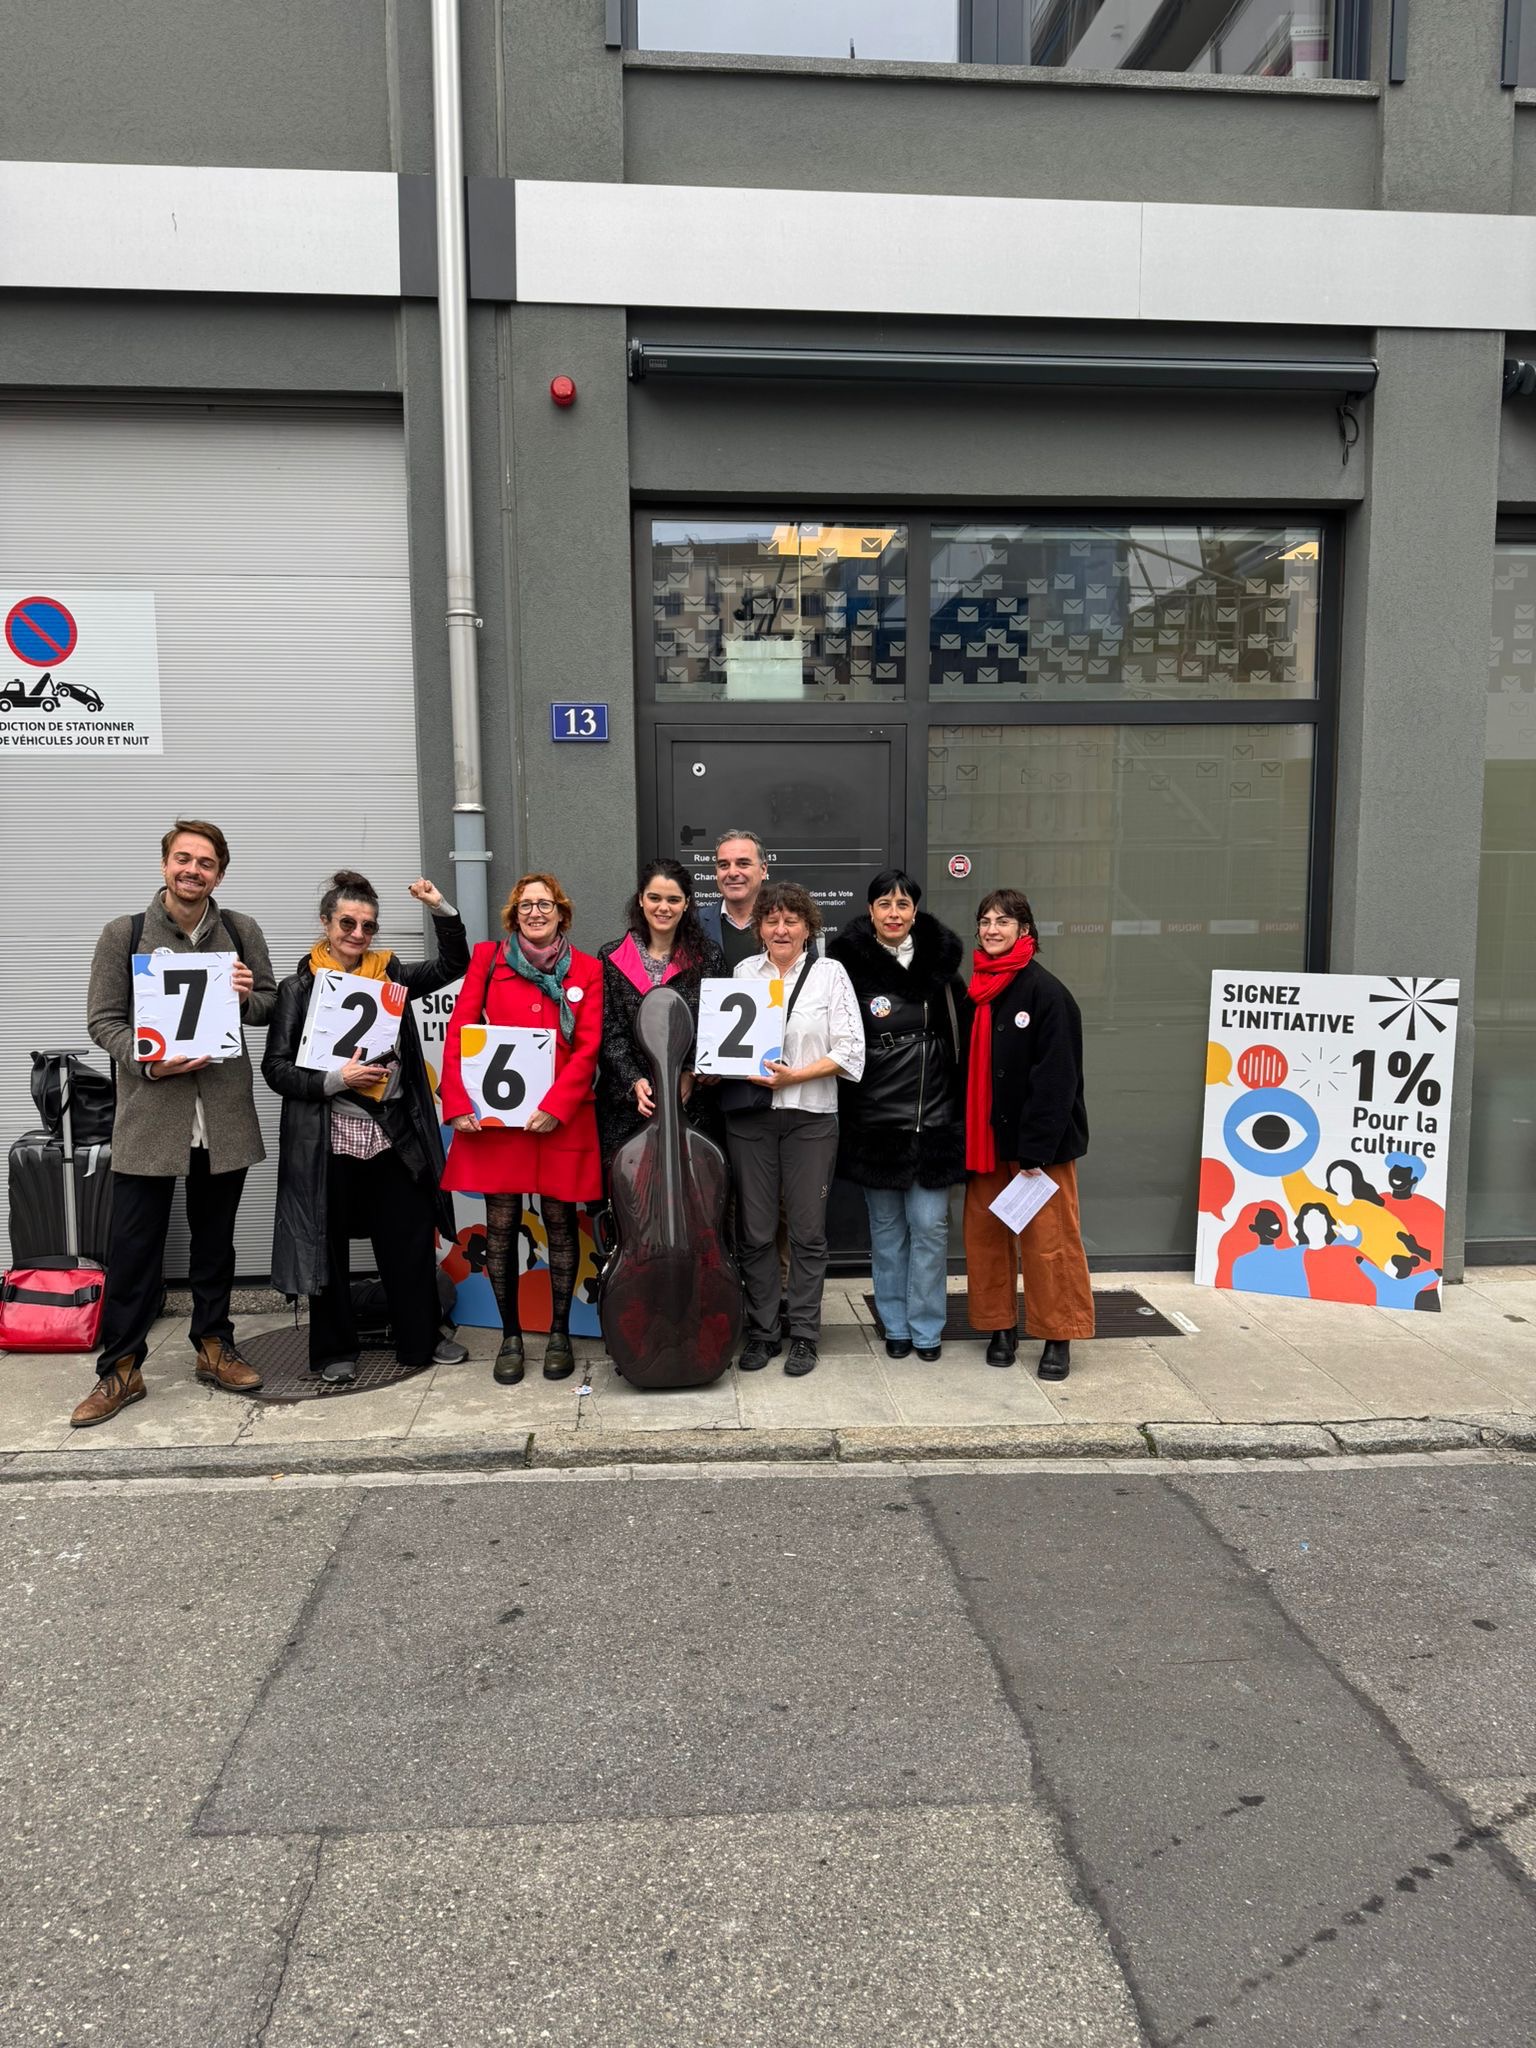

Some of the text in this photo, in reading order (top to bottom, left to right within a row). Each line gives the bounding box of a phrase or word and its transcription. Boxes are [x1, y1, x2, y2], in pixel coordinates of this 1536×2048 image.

[0, 721, 135, 731] DICTION DE STATIONNER
[564, 708, 597, 736] 13
[11, 734, 74, 746] VÉHICULES
[75, 736, 105, 746] JOUR
[107, 736, 120, 746] ET
[122, 736, 150, 746] NUIT
[693, 854, 711, 862] Rue
[767, 853, 778, 862] 13
[693, 873, 718, 881] Chan
[809, 890, 827, 898] tions
[827, 890, 837, 898] de
[838, 890, 854, 898] Vote
[163, 969, 208, 1041] 7
[1222, 983, 1301, 1006] SIGNEZ
[332, 991, 378, 1061] 2
[717, 992, 757, 1059] 2
[1221, 1009, 1355, 1034] L'INITIATIVE
[482, 1043, 526, 1111] 6
[1352, 1049, 1442, 1107] 1%
[1352, 1106, 1438, 1134] Pour la
[1350, 1133, 1437, 1159] culture
